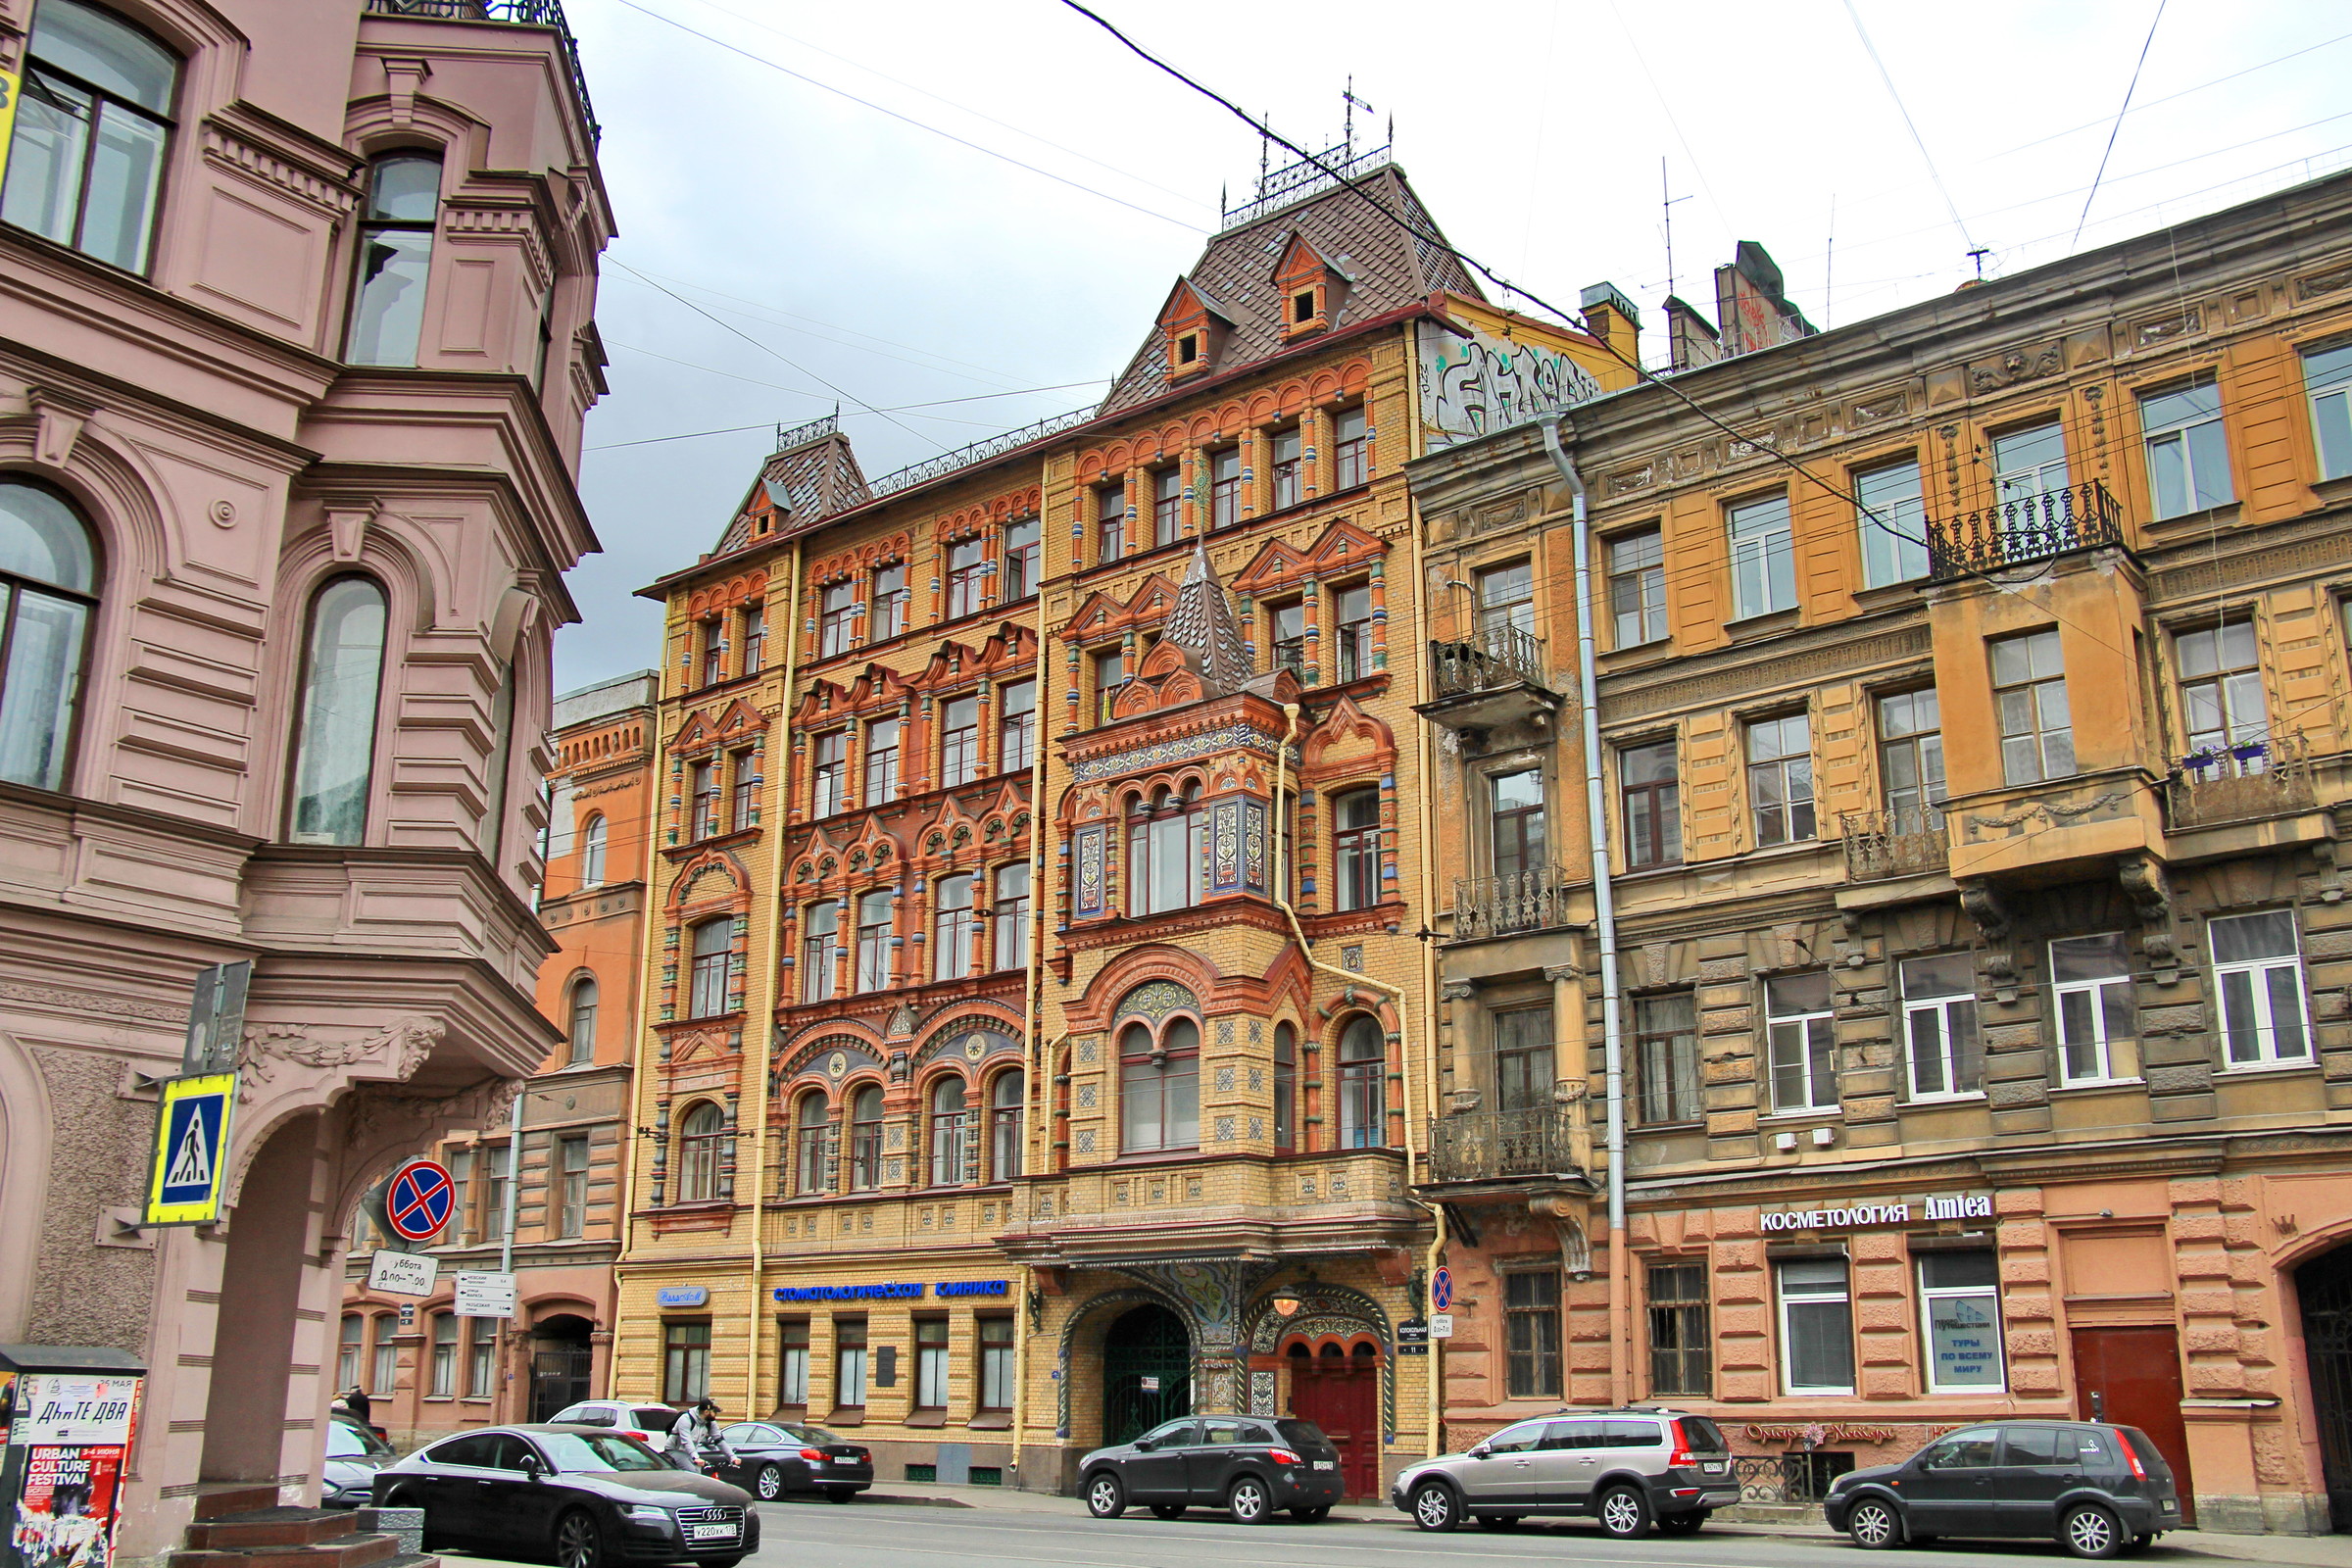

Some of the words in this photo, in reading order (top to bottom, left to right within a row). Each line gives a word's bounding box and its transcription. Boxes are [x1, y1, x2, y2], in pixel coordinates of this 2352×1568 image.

[1760, 1203, 1909, 1231] КОСМЕТОЛОГИЯ
[1924, 1195, 1991, 1220] Amiea
[773, 1283, 924, 1300] стоматологическая
[935, 1280, 1008, 1296] клиника
[1958, 1351, 1992, 1360] ВСЕМУ
[92, 1401, 127, 1424] ДВА
[31, 1447, 80, 1460] URBAN
[28, 1460, 91, 1473] CULTURE
